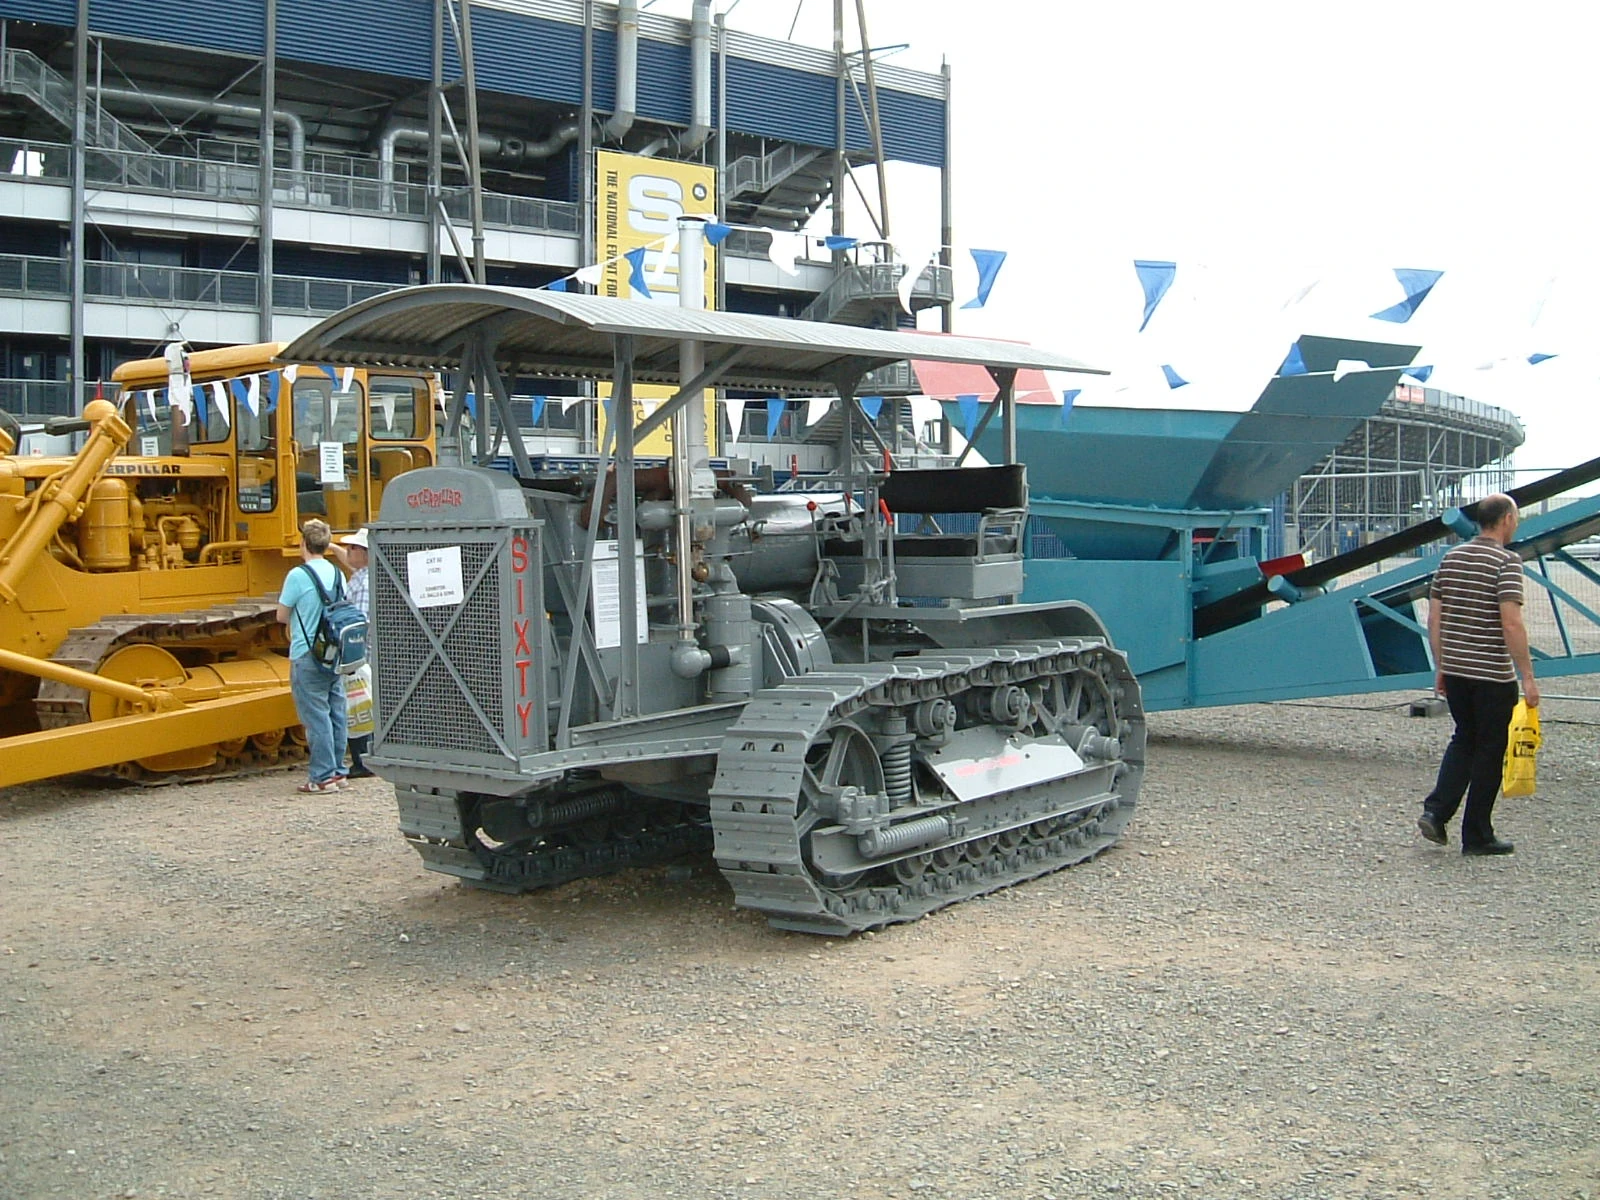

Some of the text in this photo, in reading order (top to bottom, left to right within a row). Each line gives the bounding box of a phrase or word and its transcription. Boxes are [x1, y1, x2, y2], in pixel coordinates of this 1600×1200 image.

[606, 170, 618, 297] THE NATIONAL EVENT FOR
[106, 464, 181, 474] ERPILLAR
[407, 488, 462, 508] CATERPILLAR
[511, 536, 532, 738] SIXTY
